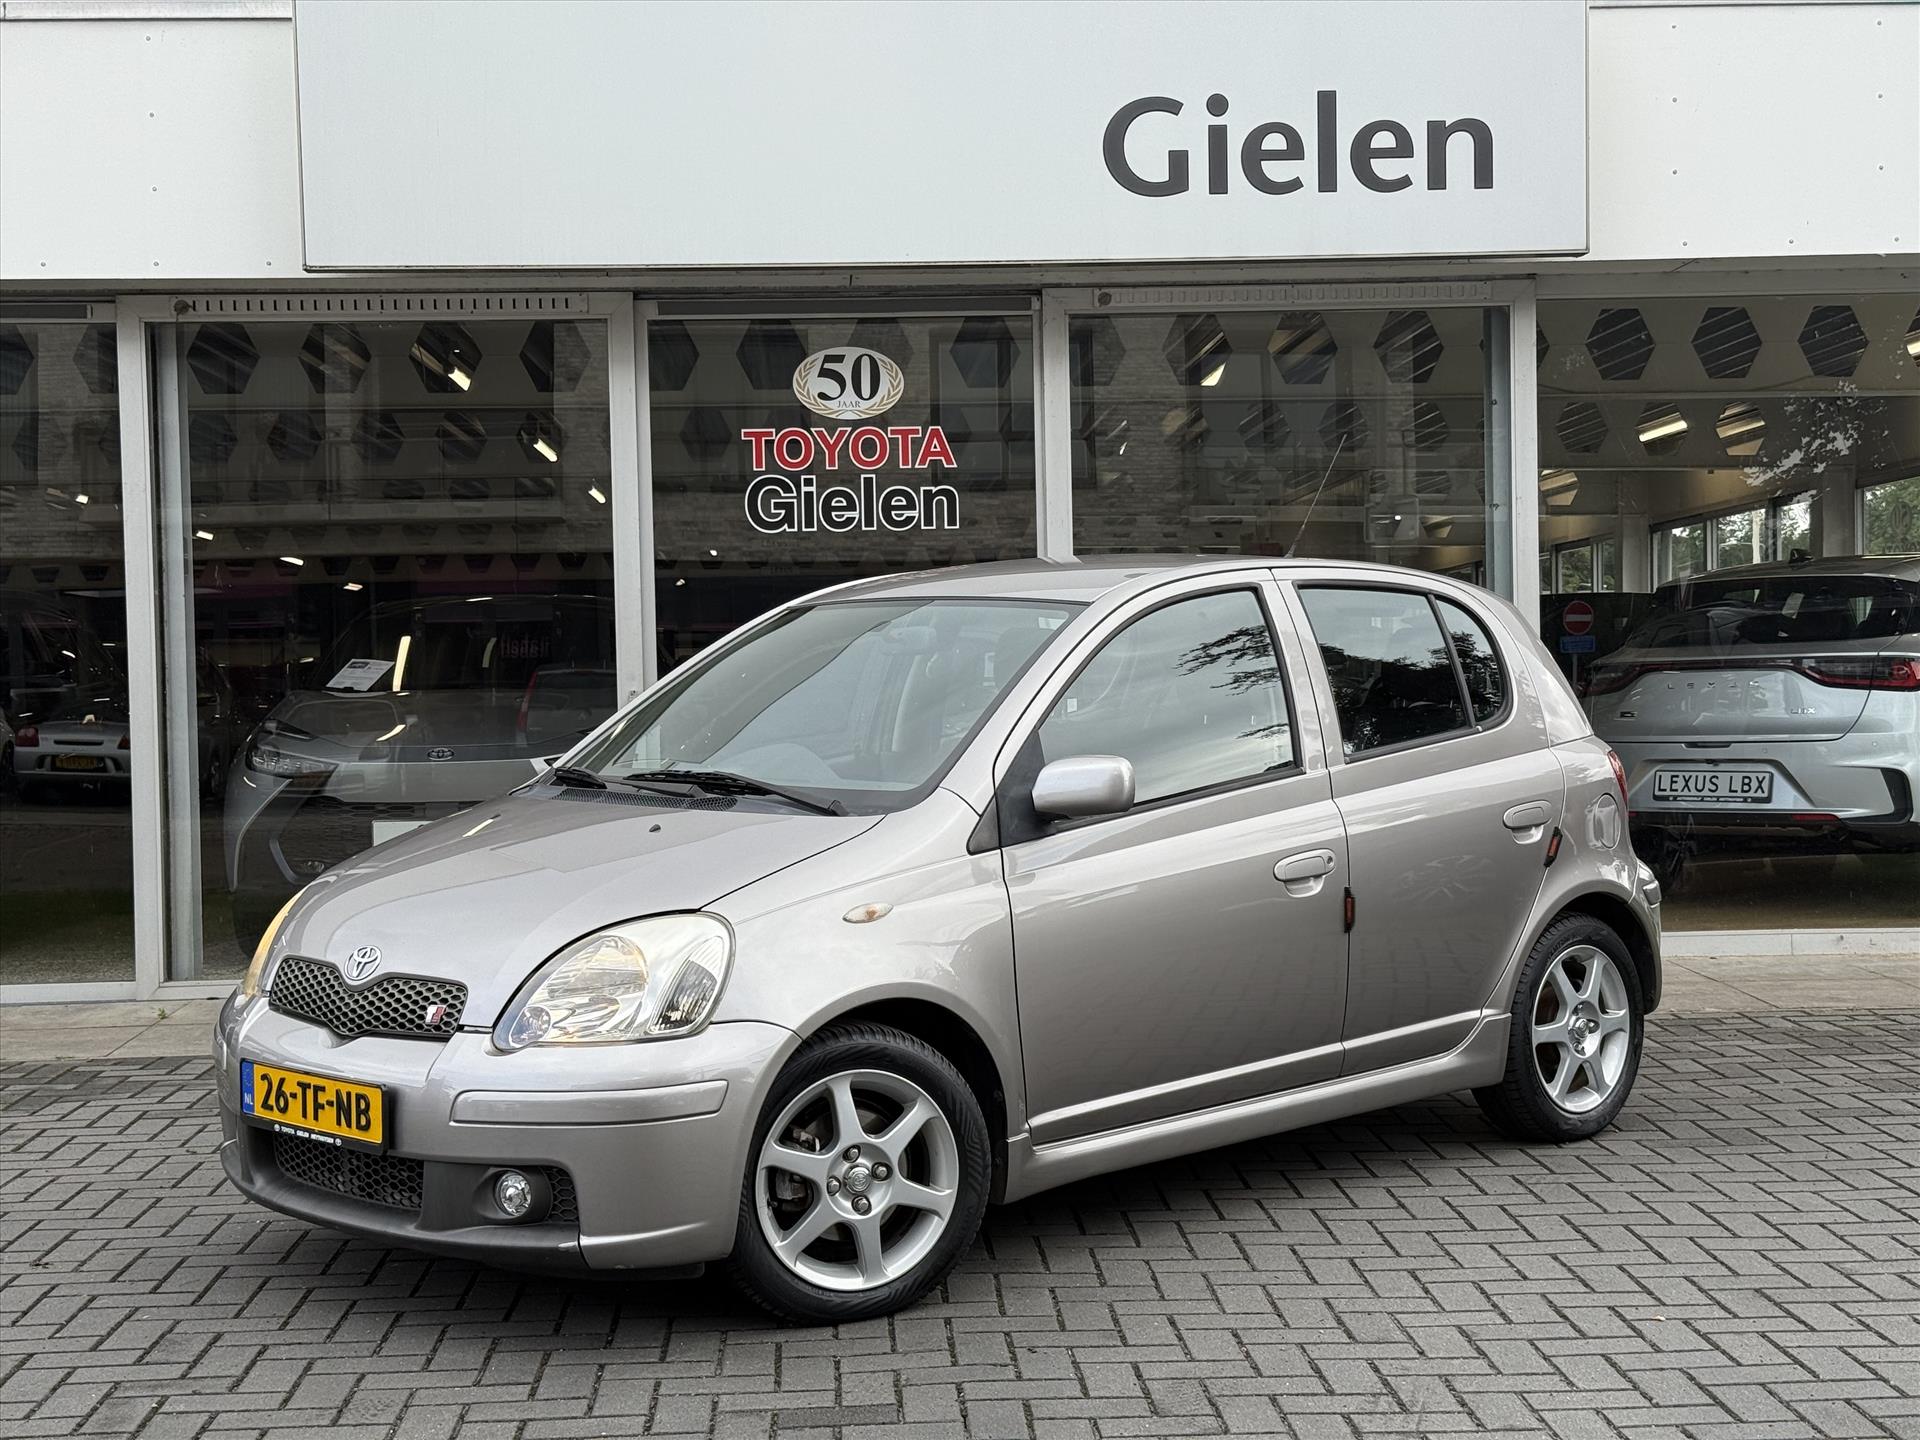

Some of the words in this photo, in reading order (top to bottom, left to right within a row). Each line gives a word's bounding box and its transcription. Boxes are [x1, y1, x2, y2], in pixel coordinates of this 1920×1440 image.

[1102, 90, 1494, 198] Gielen
[817, 353, 881, 402] 50
[837, 400, 861, 409] JAAR
[741, 426, 958, 471] TOYOTA
[744, 474, 960, 533] Gielen
[1658, 774, 1719, 793] LEXUS
[1728, 776, 1767, 794] LBX
[244, 1092, 254, 1105] NL
[260, 1072, 372, 1132] 26-TF-NB
